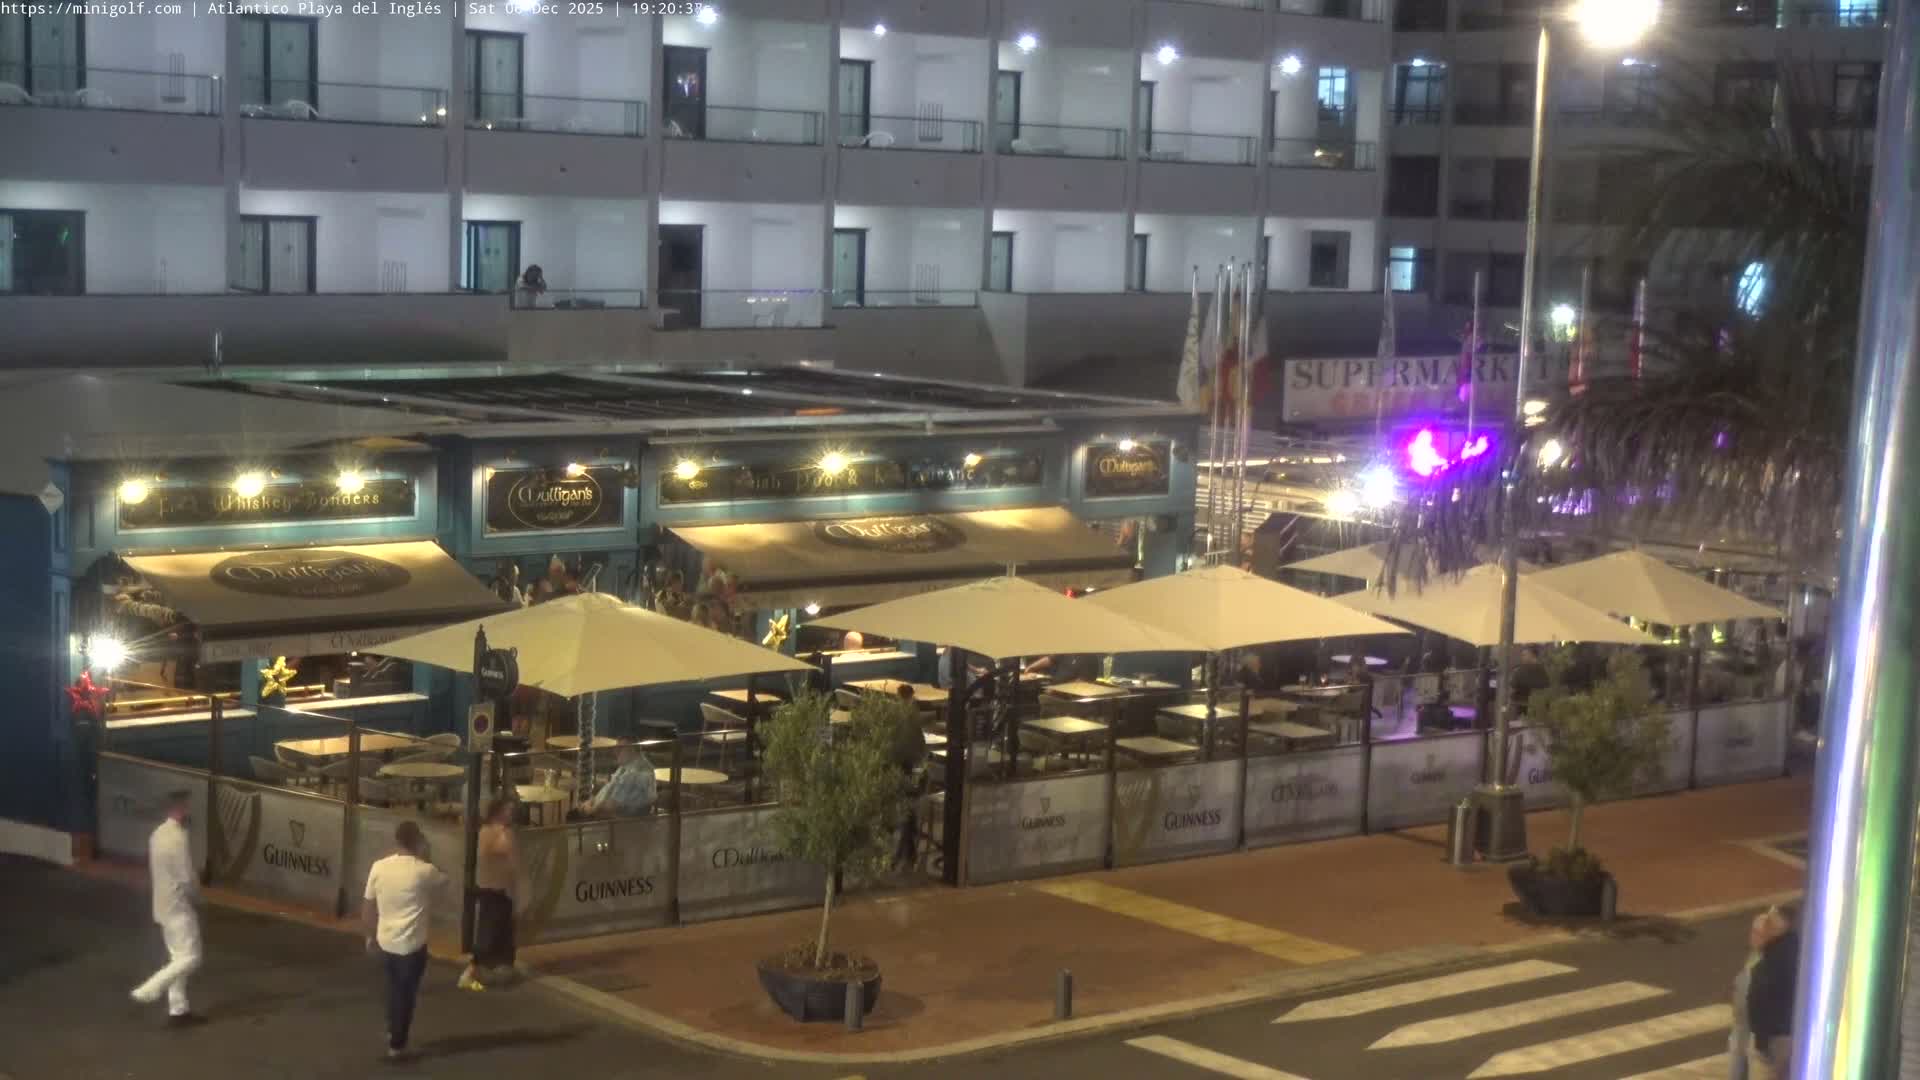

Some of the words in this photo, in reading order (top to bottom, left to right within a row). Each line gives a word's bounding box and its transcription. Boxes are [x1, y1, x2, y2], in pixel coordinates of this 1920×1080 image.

[1290, 355, 1551, 389] SUPRMARKT
[305, 491, 380, 511] onders
[518, 486, 593, 506] Mulligan's
[1164, 809, 1221, 830] GUINNESS
[264, 843, 331, 876] GUINNESS
[576, 877, 655, 903] GUINNESS
